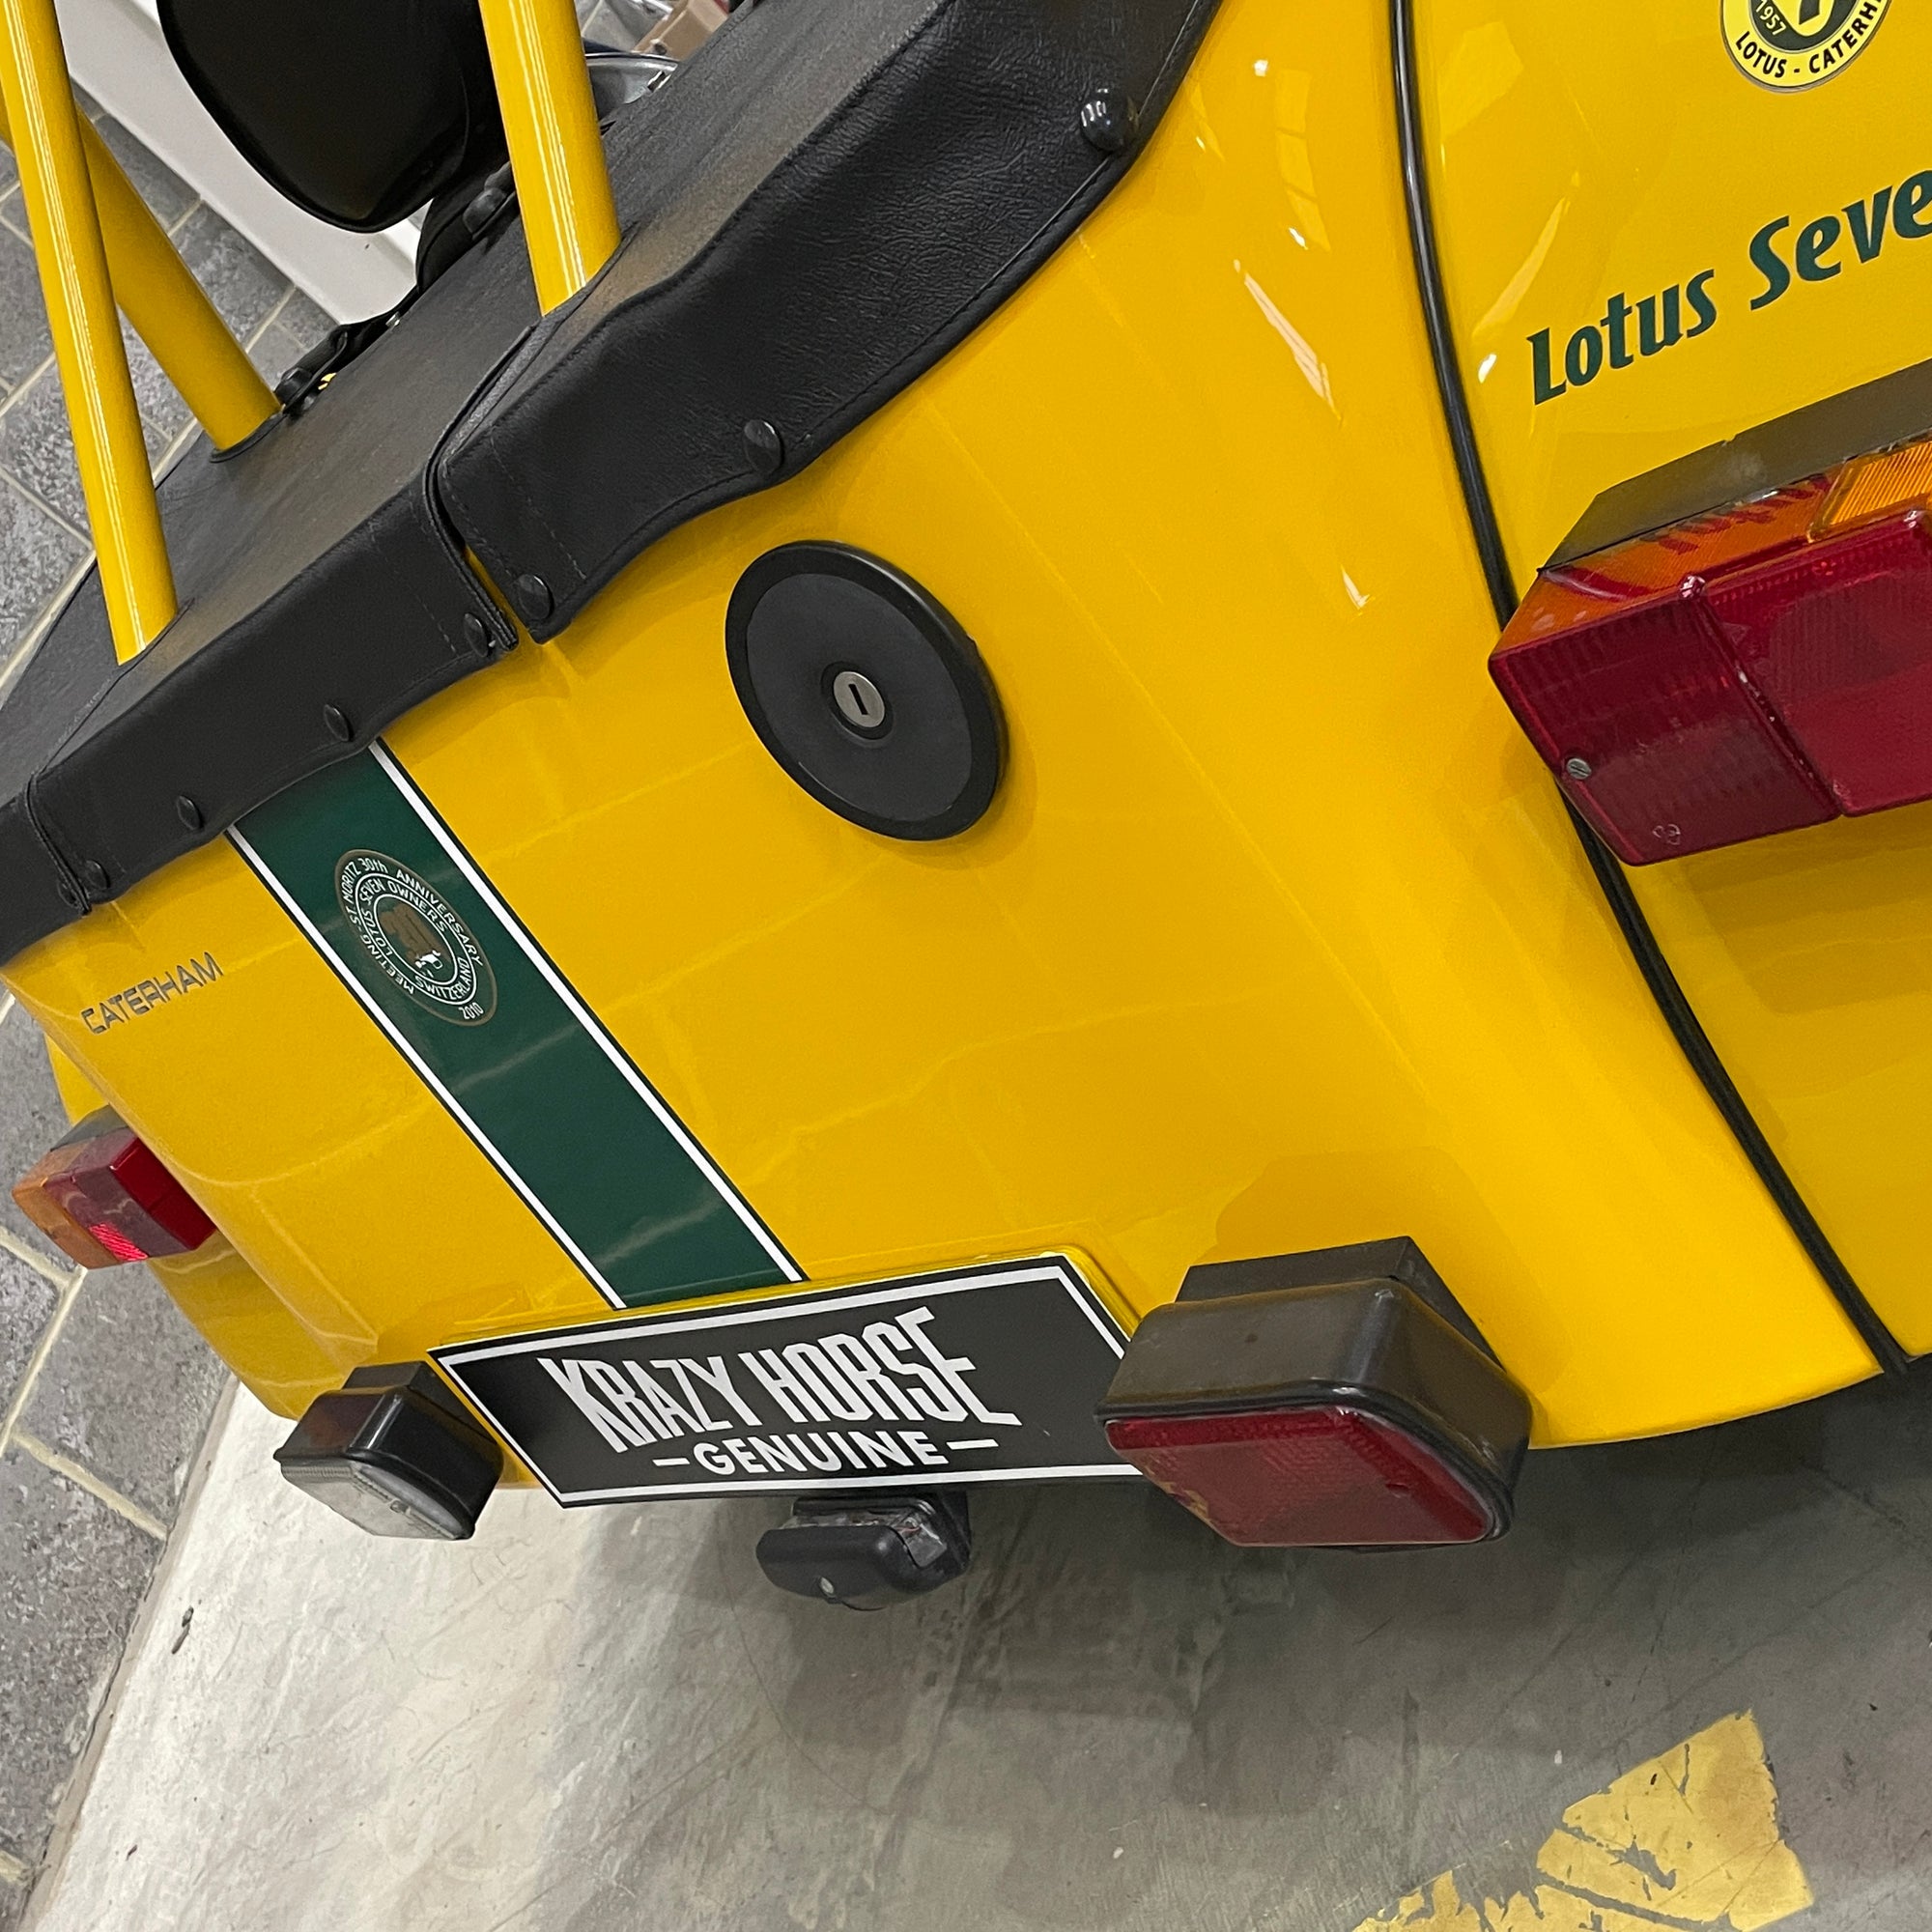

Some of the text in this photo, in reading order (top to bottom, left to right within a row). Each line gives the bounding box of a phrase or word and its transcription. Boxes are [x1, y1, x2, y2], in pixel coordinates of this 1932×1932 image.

[1735, 30, 1788, 78] LOTUS
[1808, 0, 1882, 73] CATERH
[1755, 0, 1787, 36] 1957
[1525, 269, 1718, 406] Lotus
[341, 861, 362, 905] MORITZ
[358, 877, 448, 956] LOTUS SEVEN OWNERS
[396, 868, 484, 966] ANNIVERSARY
[80, 951, 224, 1035] CATERHAM
[359, 934, 414, 994] MEETING
[414, 956, 472, 1000] SWITZERLAND
[458, 1002, 484, 1020] 2010
[536, 1306, 1023, 1455] KRAZY HORSE
[692, 1431, 950, 1477] GENUINE
